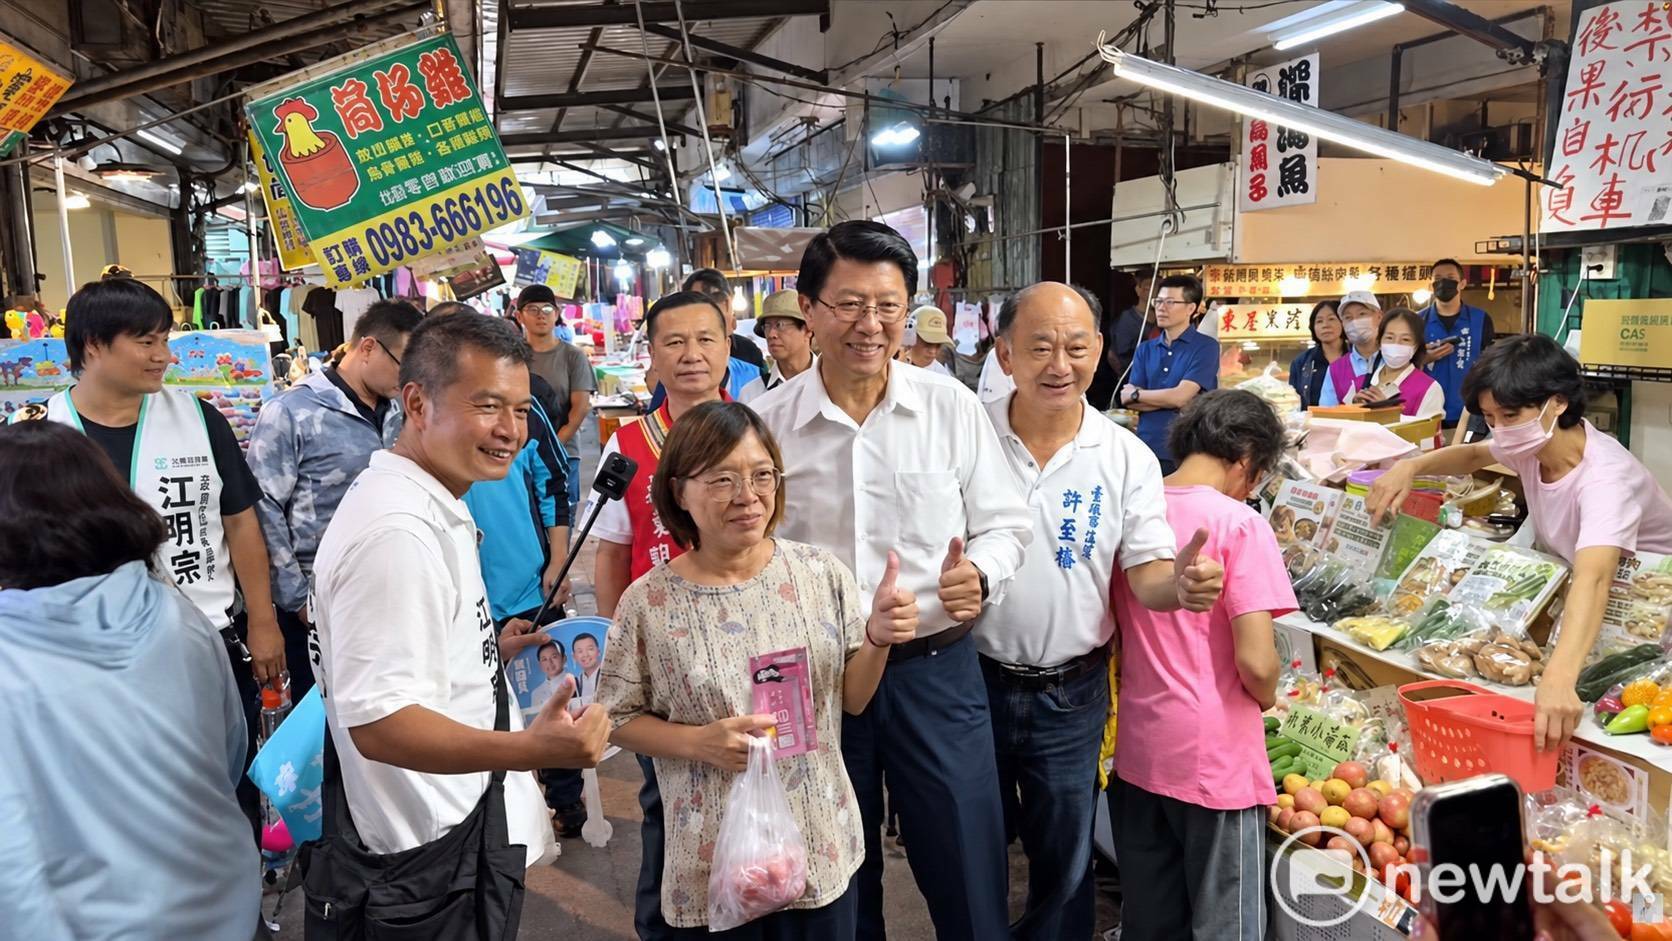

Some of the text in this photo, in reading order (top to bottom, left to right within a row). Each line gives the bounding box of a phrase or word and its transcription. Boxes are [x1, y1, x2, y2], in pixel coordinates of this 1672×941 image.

[1549, 6, 1623, 225] 後果自負
[365, 177, 523, 267] 0983-666196
[1620, 328, 1646, 339] CAS
[158, 475, 202, 585] 江明宗
